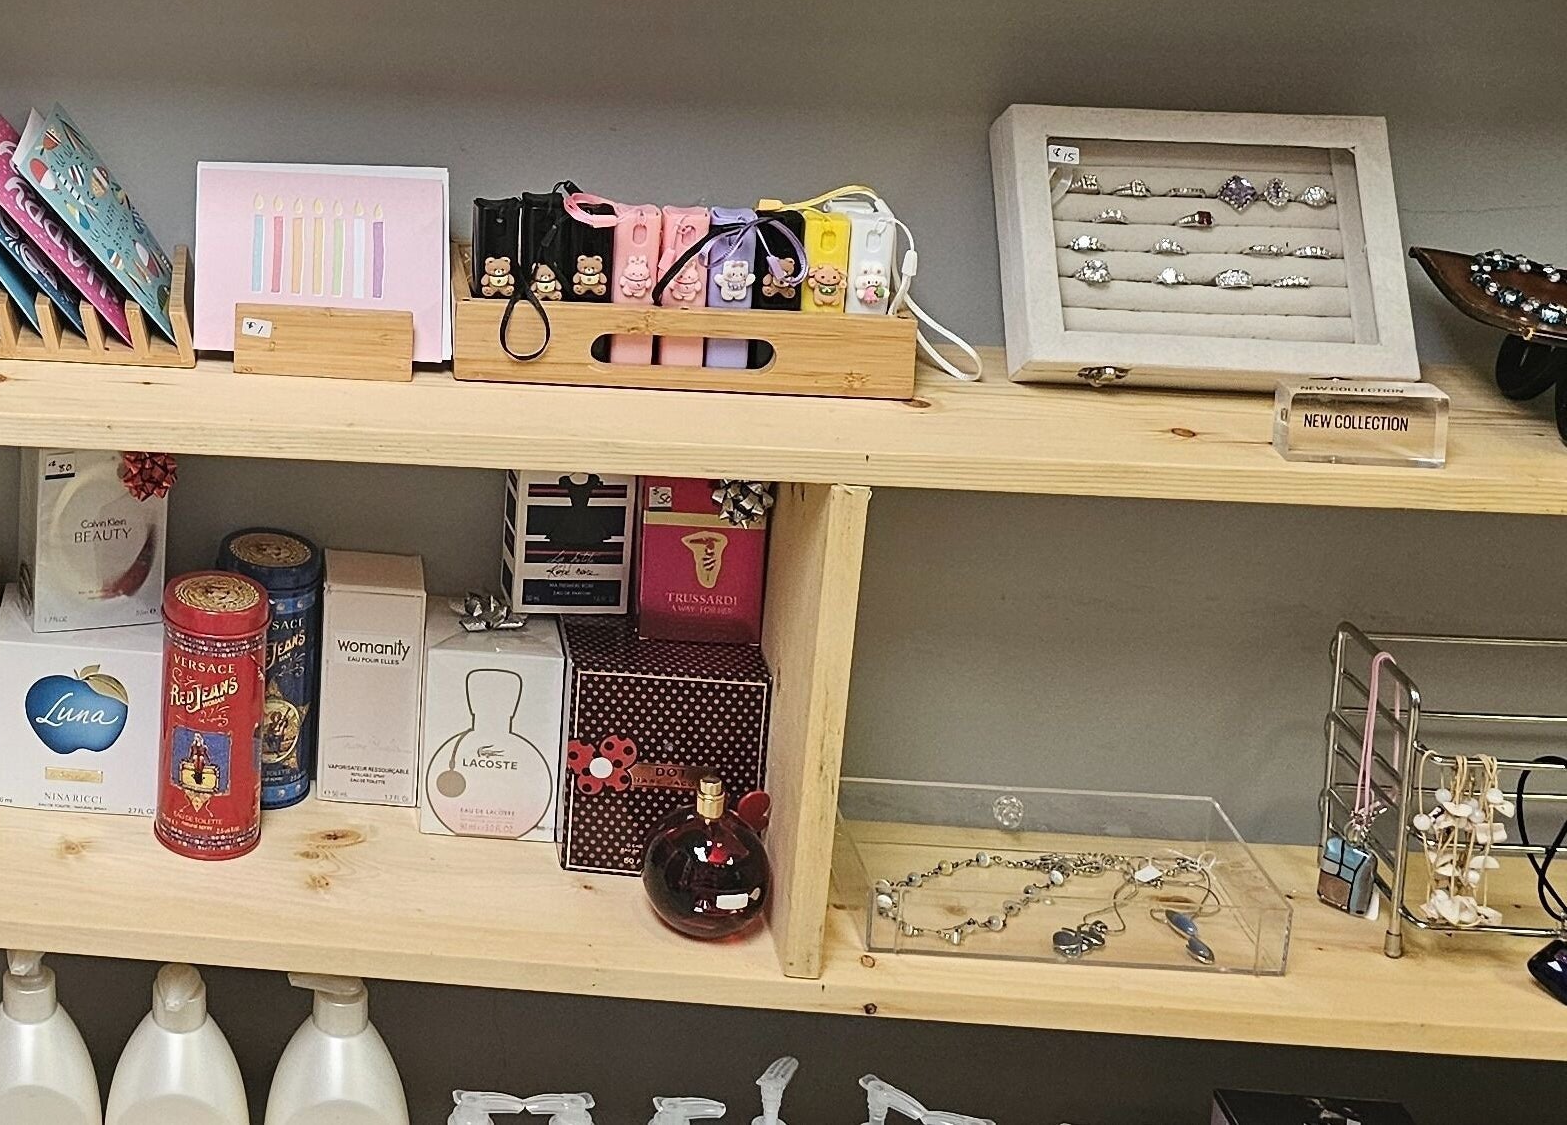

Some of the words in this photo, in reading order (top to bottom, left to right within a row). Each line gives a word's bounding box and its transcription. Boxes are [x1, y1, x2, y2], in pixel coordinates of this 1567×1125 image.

[1304, 413, 1331, 428] NEW
[1334, 415, 1409, 431] COLLECTION
[81, 519, 106, 528] Calvin
[107, 518, 127, 527] Klein
[74, 527, 132, 543] BEAUTY
[666, 592, 737, 606] TRUSSARDI
[272, 617, 304, 631] SACE
[174, 653, 236, 674] VERSACE
[36, 692, 119, 727] Luna
[462, 758, 518, 770] LACOSTE
[44, 792, 72, 801] NINA
[73, 794, 103, 804] RICCI
